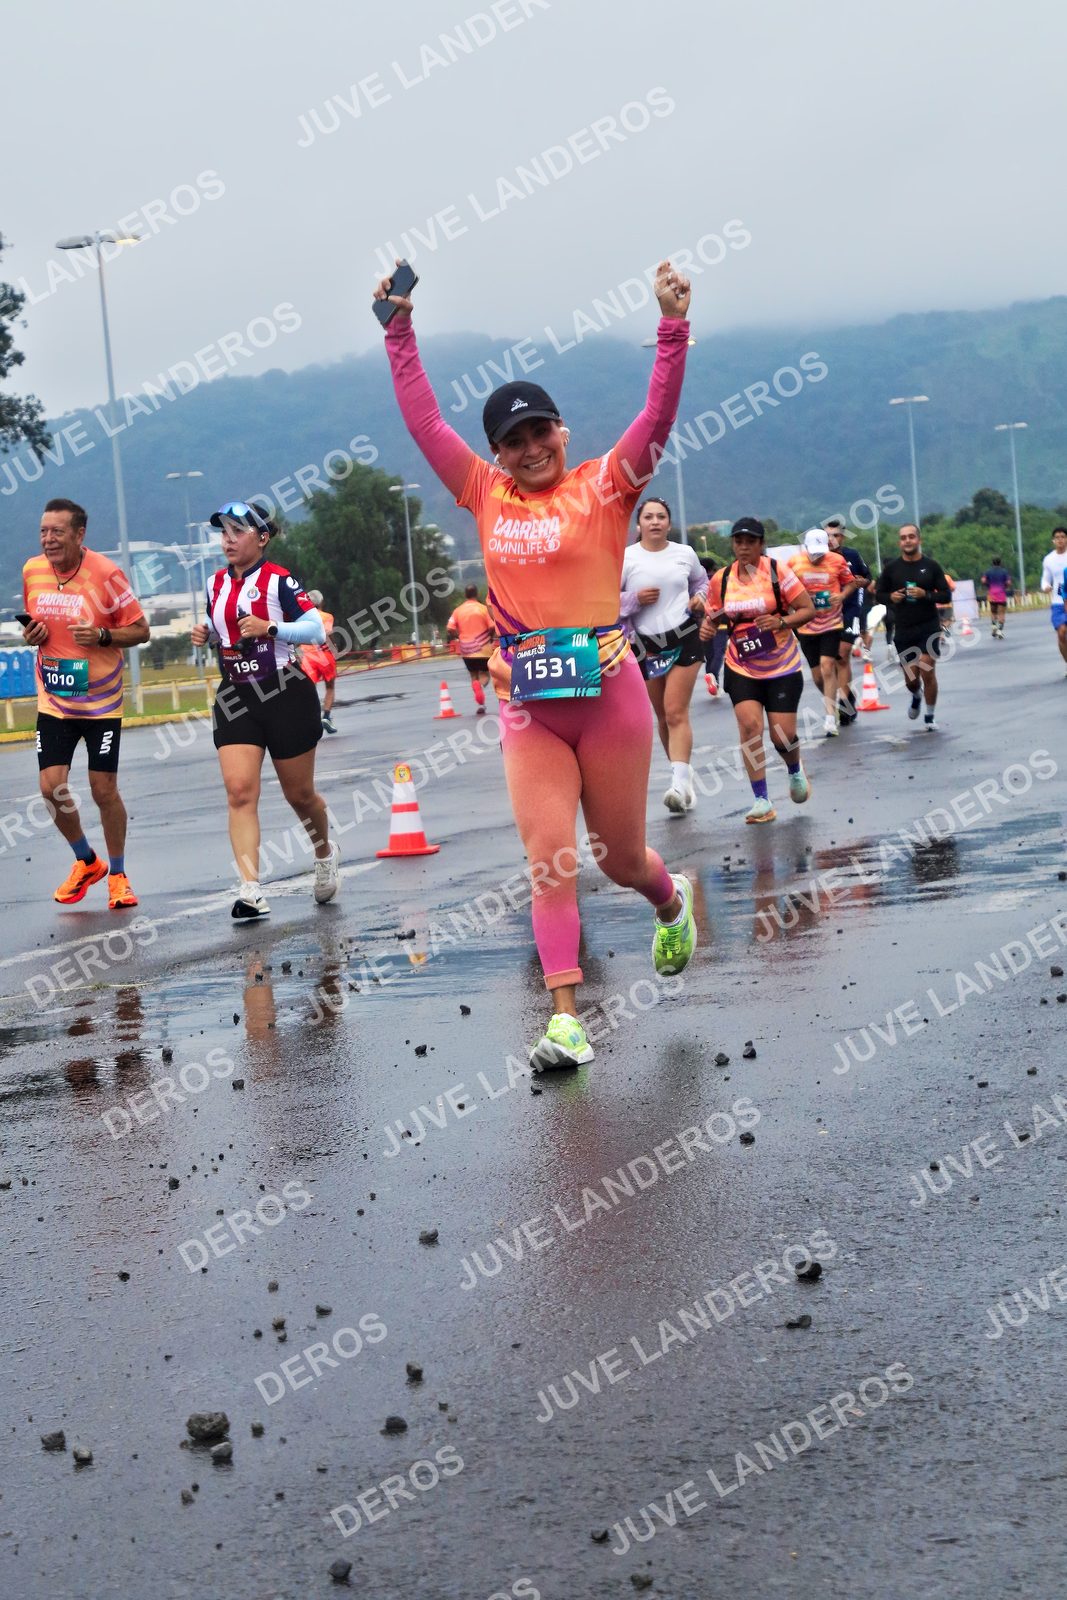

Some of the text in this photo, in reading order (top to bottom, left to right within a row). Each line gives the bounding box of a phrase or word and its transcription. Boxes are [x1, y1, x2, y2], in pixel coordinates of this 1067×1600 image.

[493, 514, 560, 540] CARRERA
[572, 632, 589, 647] 10K
[742, 638, 762, 652] 531
[233, 659, 260, 674] 196
[523, 657, 577, 680] 1531
[46, 672, 75, 686] 1010
